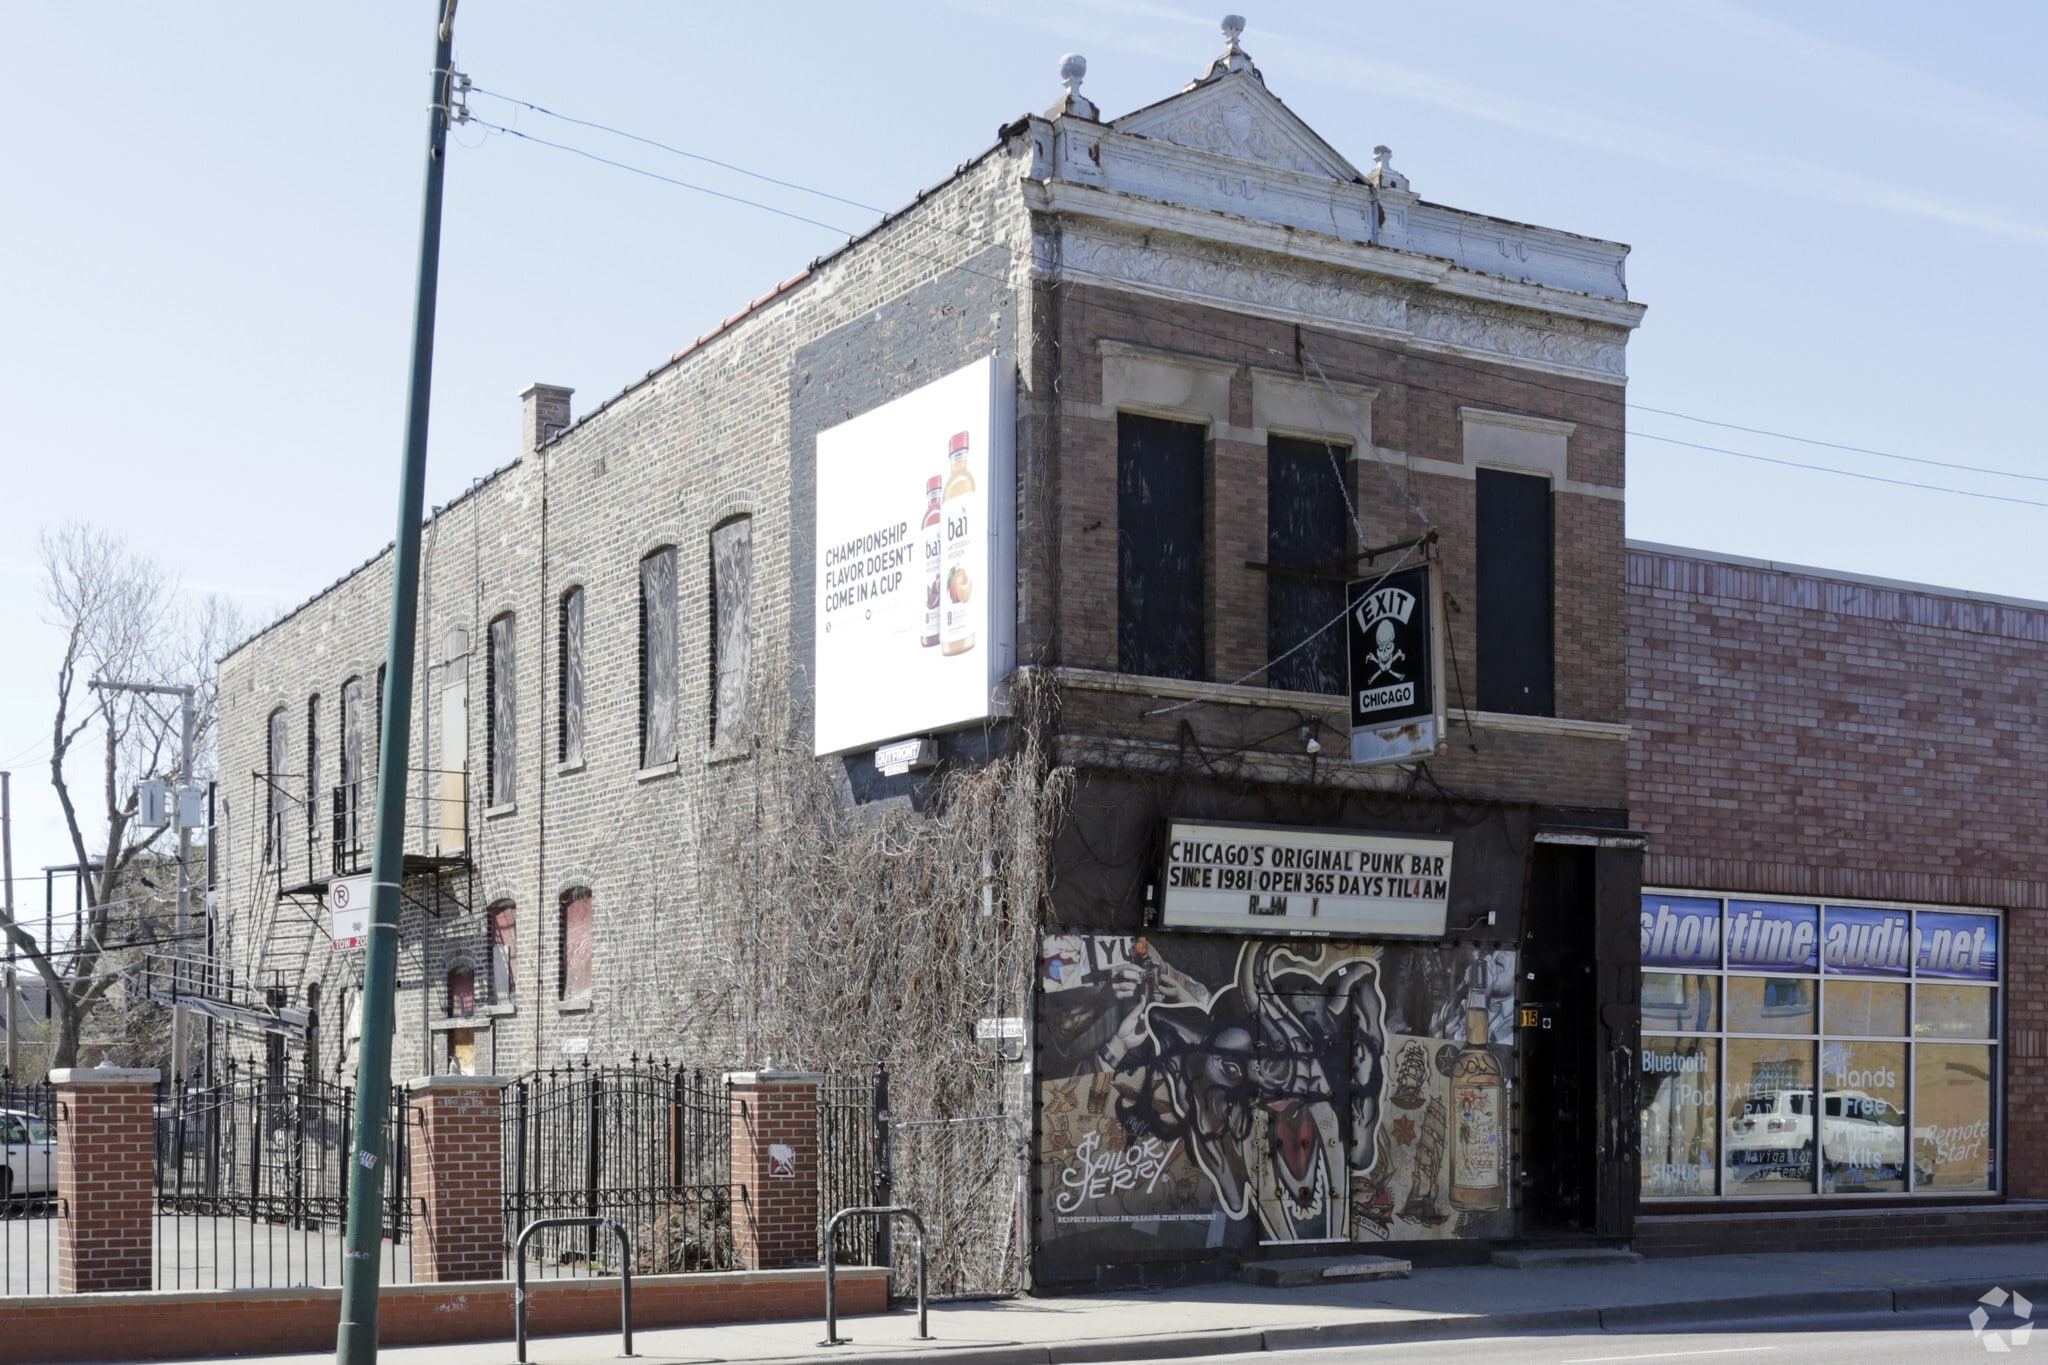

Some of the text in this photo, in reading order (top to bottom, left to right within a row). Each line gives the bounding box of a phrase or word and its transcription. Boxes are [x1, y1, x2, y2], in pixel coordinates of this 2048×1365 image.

[947, 511, 968, 541] bai
[826, 522, 907, 567] CHAMPIONSHIP
[826, 561, 864, 590] FLAVOR
[867, 543, 914, 576] DOESN'T
[826, 571, 902, 612] COME IN A CUP
[1362, 591, 1407, 624] EXIT
[1363, 687, 1411, 708] CHICAGO
[1170, 842, 1444, 877] CHICAGO'S ORIGINAL PUNK BAR
[1169, 866, 1212, 888] SINCE
[1217, 869, 1253, 890] 1981
[1259, 871, 1301, 892] OPEN
[1304, 873, 1335, 894] 365
[1339, 875, 1383, 897] DAYS
[336, 936, 368, 950] TOW ZO
[1521, 1010, 1537, 1026] 15
[1642, 1050, 1708, 1072] Bluetooth
[1837, 1065, 1895, 1088] Hands
[1675, 1083, 1715, 1107] iPod
[1845, 1096, 1886, 1116] Free
[1923, 1119, 1989, 1146] Remote
[1062, 1135, 1163, 1187] SAILOR
[1744, 1150, 1813, 1165] Navigation
[1849, 1146, 1881, 1169] Kits
[1935, 1139, 1982, 1165] Start
[1057, 1131, 1182, 1212] JERRY
[1651, 1164, 1699, 1181] SIRIUS
